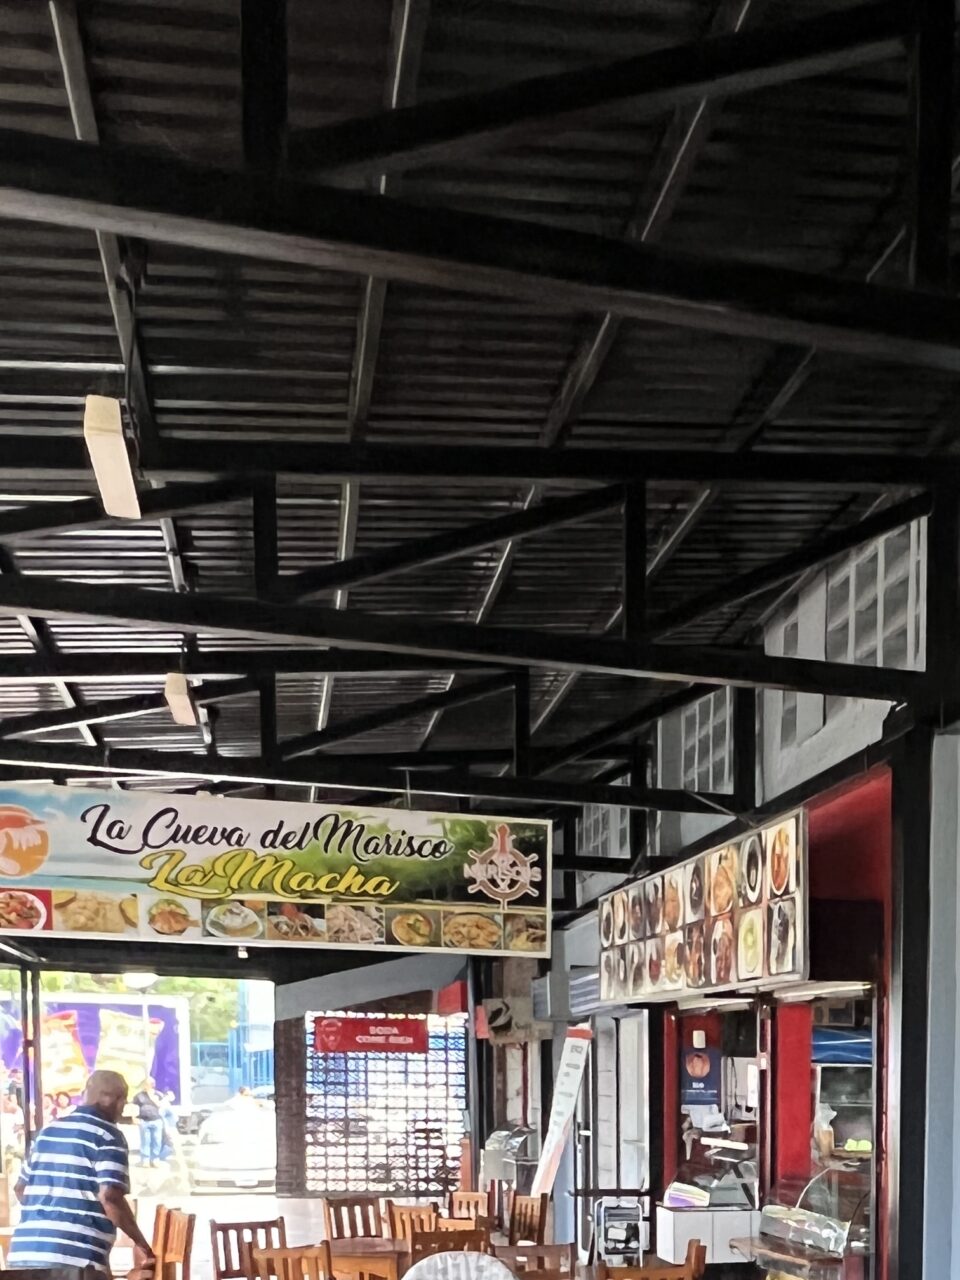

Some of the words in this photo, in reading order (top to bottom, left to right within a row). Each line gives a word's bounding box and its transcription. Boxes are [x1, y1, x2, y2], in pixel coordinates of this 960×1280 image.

[80, 804, 144, 854] La
[142, 807, 250, 849] Cueva
[260, 820, 312, 850] del
[313, 813, 454, 863] Marisco
[139, 849, 234, 899] La
[211, 848, 400, 899] Macha
